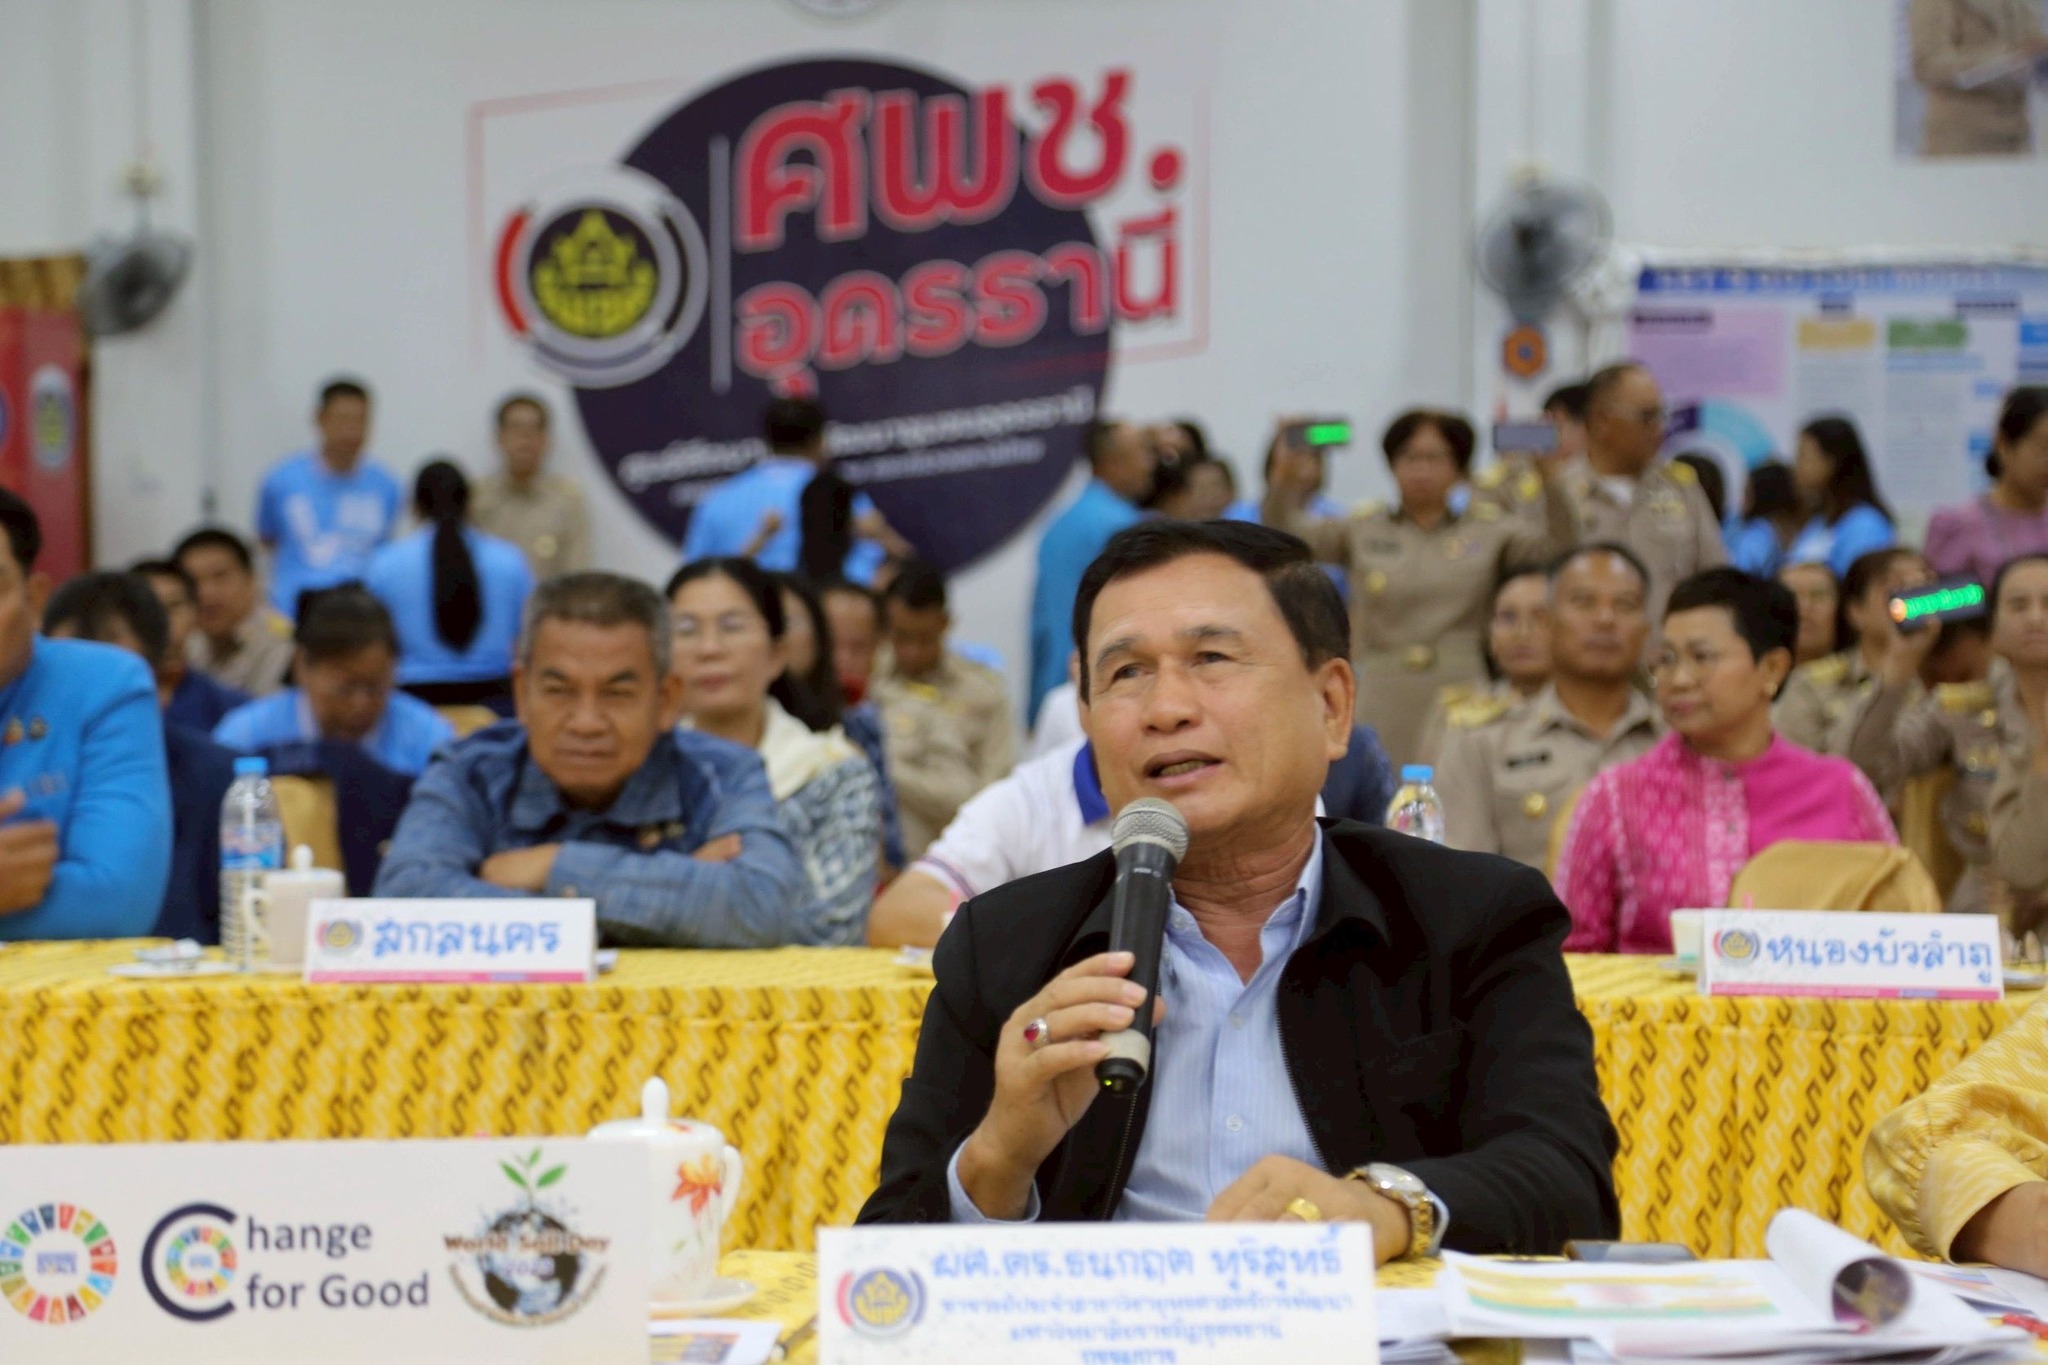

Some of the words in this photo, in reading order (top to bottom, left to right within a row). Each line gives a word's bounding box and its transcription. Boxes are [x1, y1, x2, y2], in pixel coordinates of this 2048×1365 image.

[733, 68, 1182, 253] ศพช.
[733, 204, 1178, 398] อุดรธานี
[373, 918, 560, 957] สกลนคร
[1766, 927, 1993, 984] หนองบัวลำภู
[444, 1231, 508, 1252] World
[567, 1230, 609, 1254] Day
[246, 1272, 304, 1308] for
[319, 1272, 429, 1308] Good
